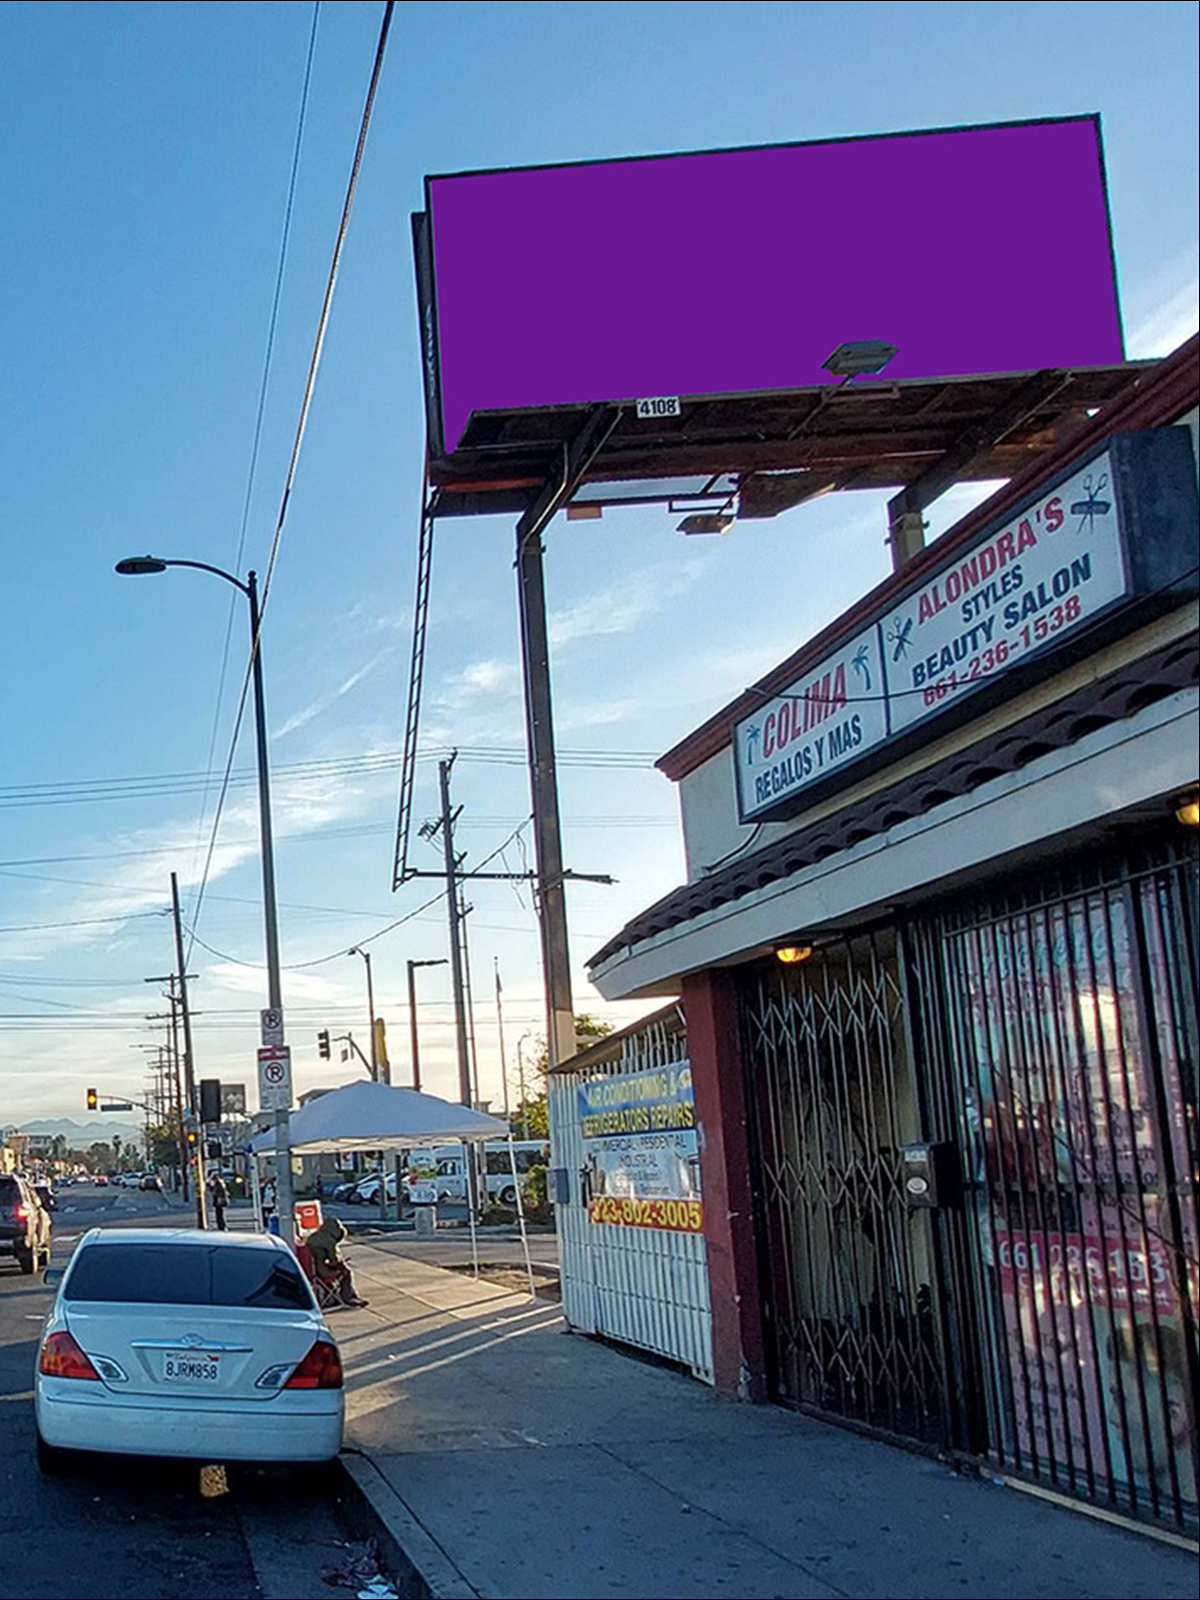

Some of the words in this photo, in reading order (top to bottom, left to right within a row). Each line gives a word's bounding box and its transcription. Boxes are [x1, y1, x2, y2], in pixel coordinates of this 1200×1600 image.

[640, 398, 677, 416] 4108
[917, 496, 1065, 626] ALONDRA'S
[961, 563, 1023, 623] STYLES
[911, 614, 995, 688] BEAUTY
[1003, 552, 1092, 631] SALON
[922, 594, 1082, 707] 661-236-1538
[762, 661, 848, 759] COLIMA
[754, 747, 813, 804] REGALOS
[813, 736, 826, 768] Y
[828, 713, 863, 761] MAS
[650, 1100, 695, 1131] REPAIRS
[166, 1360, 218, 1380] 8JRM858
